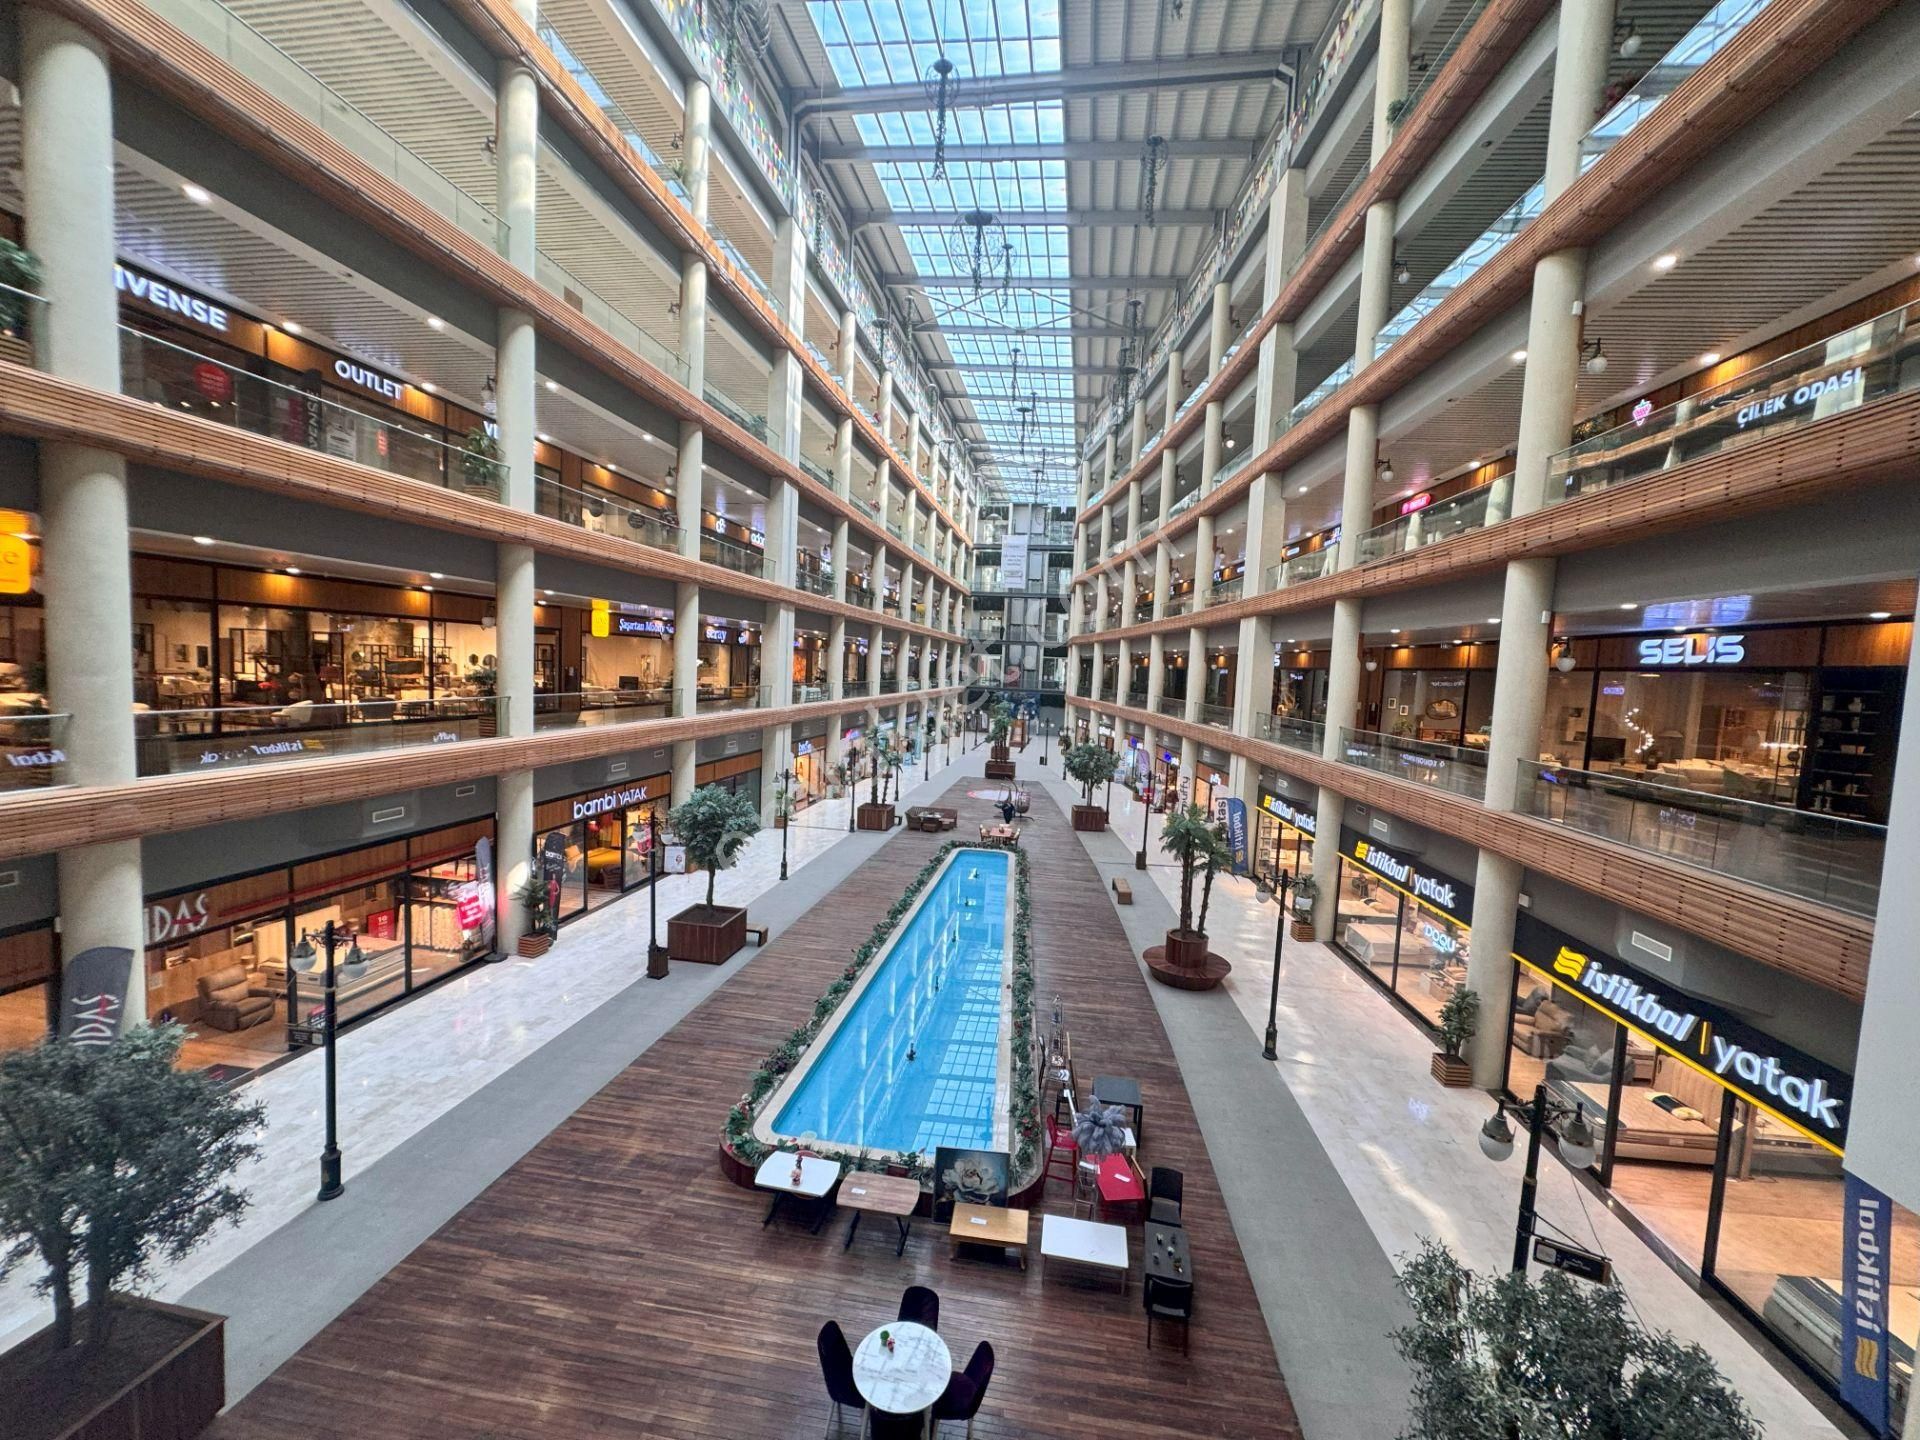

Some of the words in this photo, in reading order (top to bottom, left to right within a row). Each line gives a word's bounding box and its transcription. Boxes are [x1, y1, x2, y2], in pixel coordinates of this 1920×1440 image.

[335, 360, 402, 400] OUTLET
[1793, 366, 1862, 405] ODASI
[574, 791, 617, 818] bambi
[618, 787, 647, 805] YATAK
[1366, 846, 1410, 882] istikbal
[1414, 874, 1456, 908] yatak
[1582, 961, 1698, 1042] istikbal
[1711, 1035, 1842, 1129] yatak
